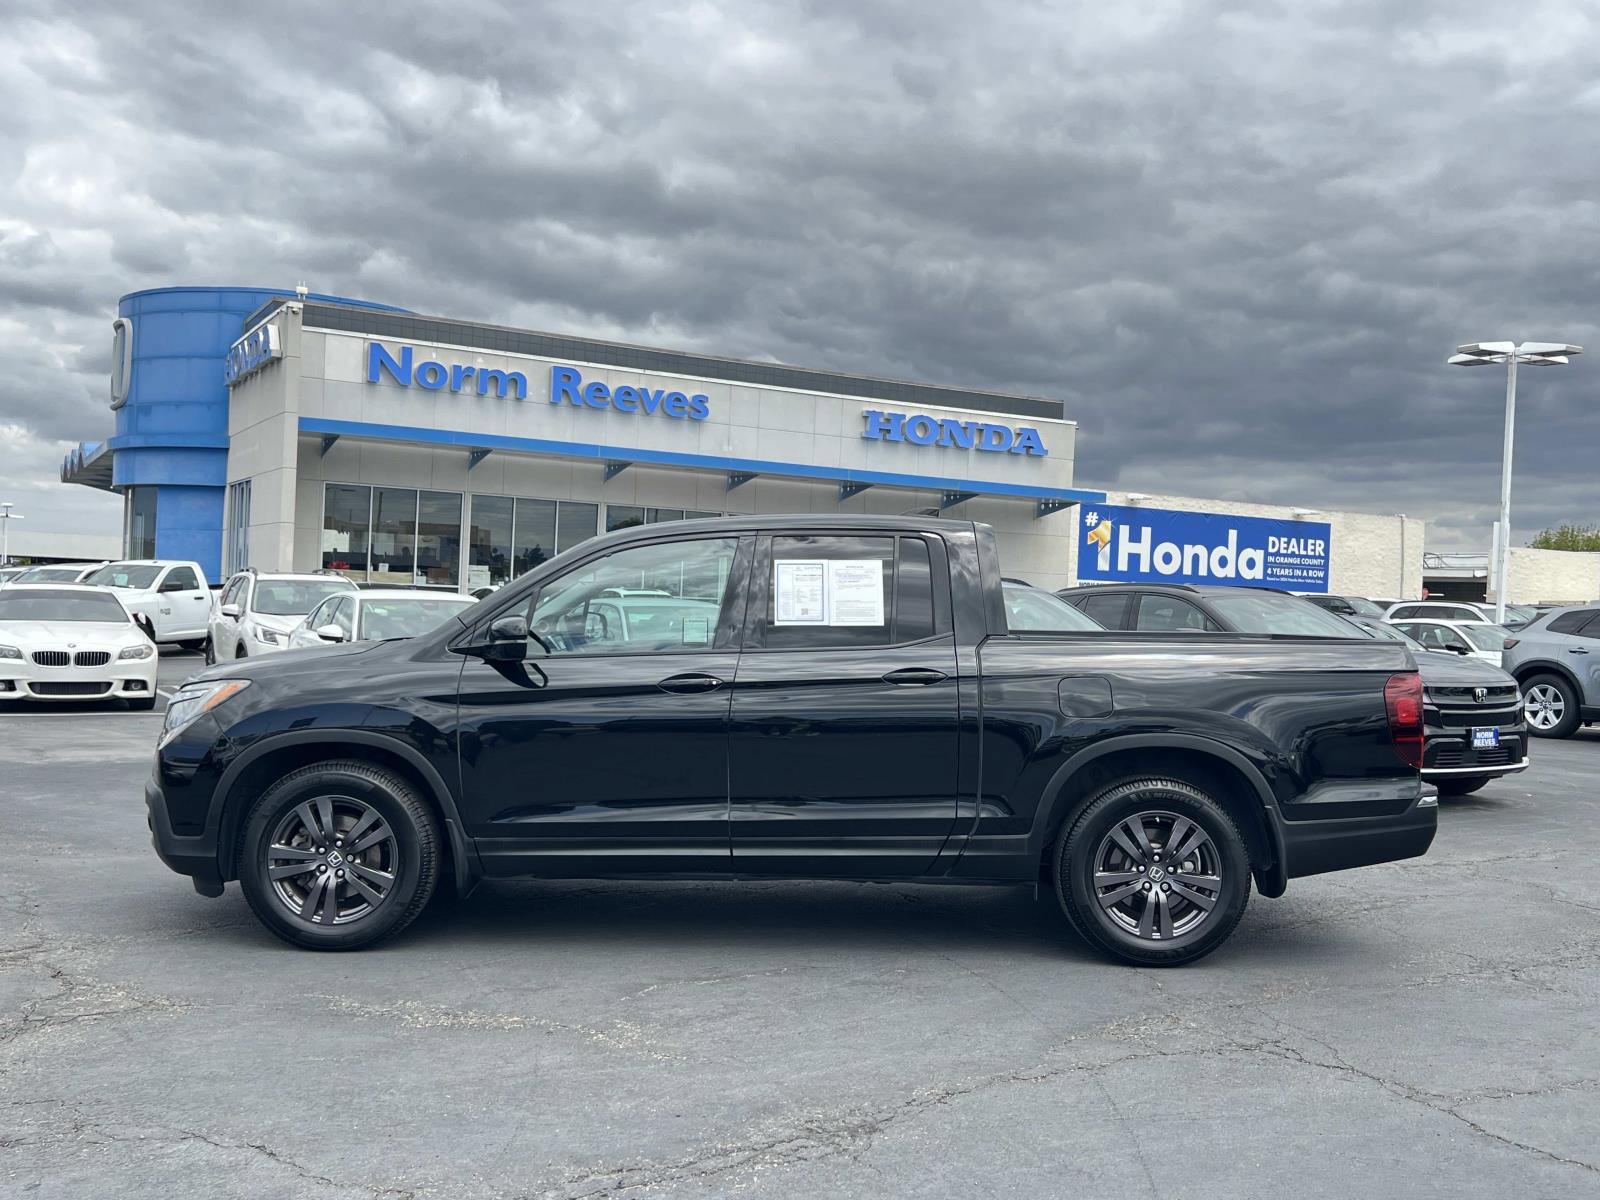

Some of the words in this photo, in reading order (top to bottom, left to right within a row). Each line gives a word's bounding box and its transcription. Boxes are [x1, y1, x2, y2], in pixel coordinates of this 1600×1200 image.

[367, 342, 528, 400] Norm
[550, 365, 710, 421] Reeves
[861, 410, 1049, 456] HONDA
[1117, 524, 1265, 580] Honda
[1268, 536, 1325, 556] DEALER
[1275, 557, 1301, 565] ORANGE
